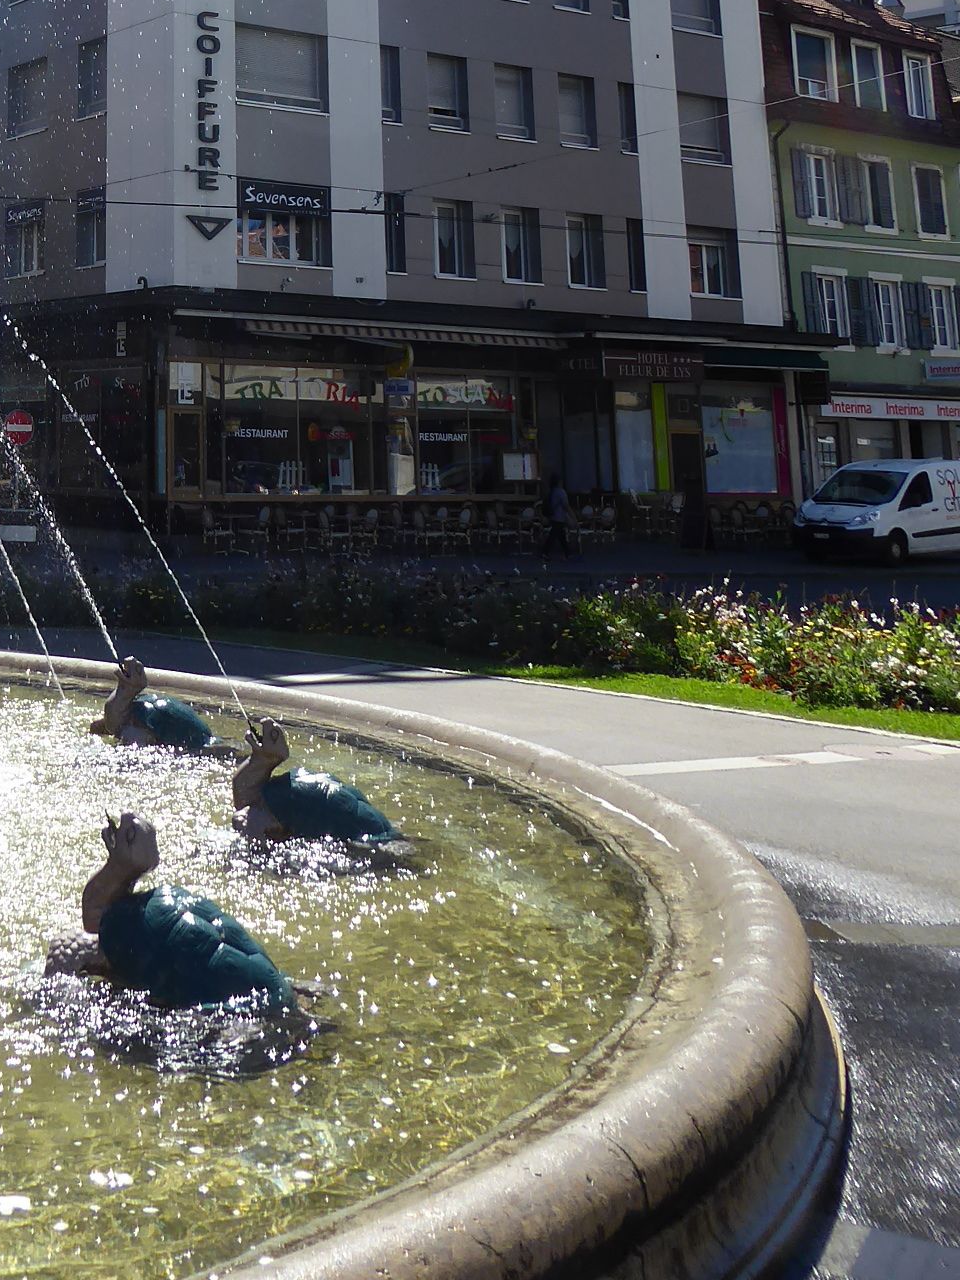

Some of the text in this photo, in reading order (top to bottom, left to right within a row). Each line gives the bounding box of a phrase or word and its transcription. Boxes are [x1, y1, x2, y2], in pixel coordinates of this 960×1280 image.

[196, 11, 221, 191] COIFFURE
[244, 186, 321, 209] Sevensens
[637, 352, 670, 366] HOTEL
[619, 364, 692, 379] FLEUR DE LYS
[234, 376, 361, 414] TRATTORIA
[831, 400, 872, 415] Interima
[886, 402, 925, 417] Interima
[234, 428, 289, 439] RESTAURANT
[419, 432, 468, 443] RESTAURANT
